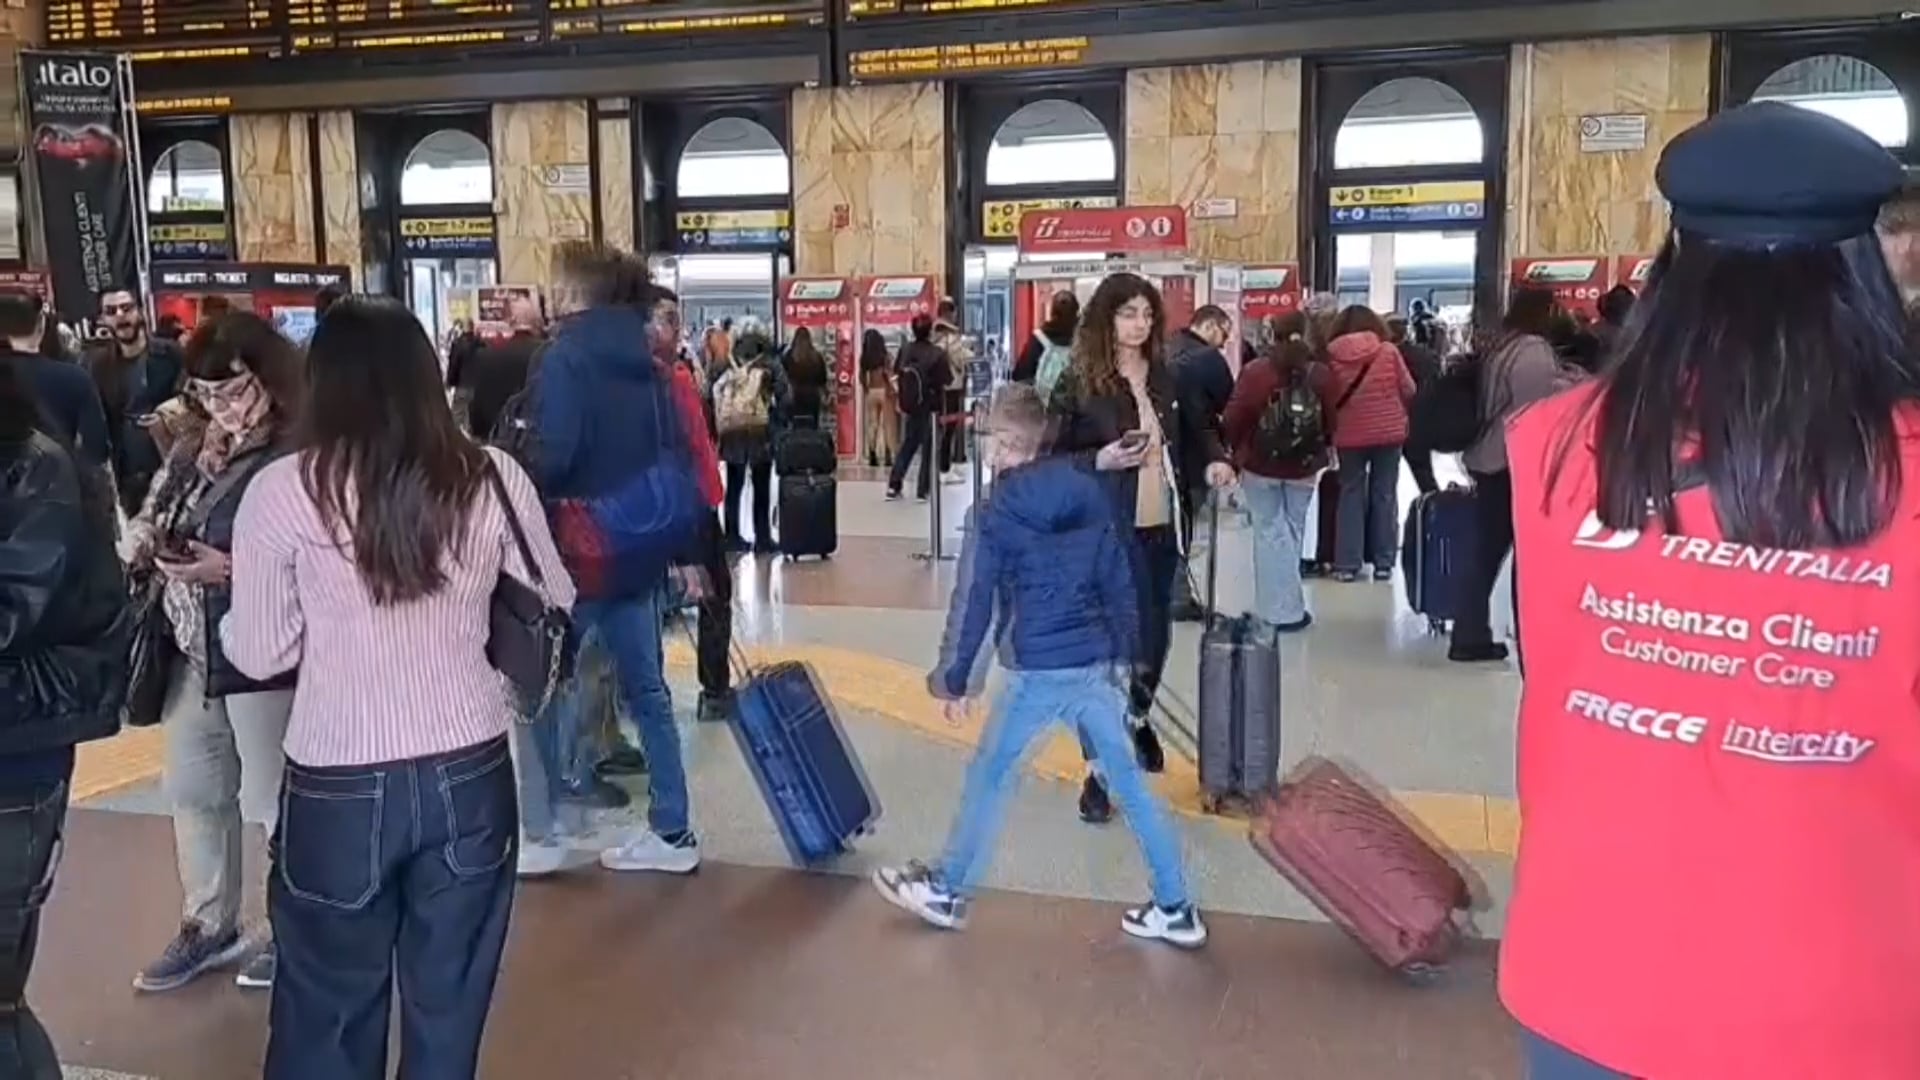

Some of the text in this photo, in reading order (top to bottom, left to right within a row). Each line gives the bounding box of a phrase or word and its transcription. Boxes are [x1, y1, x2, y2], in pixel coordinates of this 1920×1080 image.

[1660, 534, 1892, 588] TRENITALIA
[1578, 583, 1879, 657] Assistenza Clienti
[1600, 627, 1835, 688] Customer Care
[1565, 689, 1875, 761] FRECCE intercity
